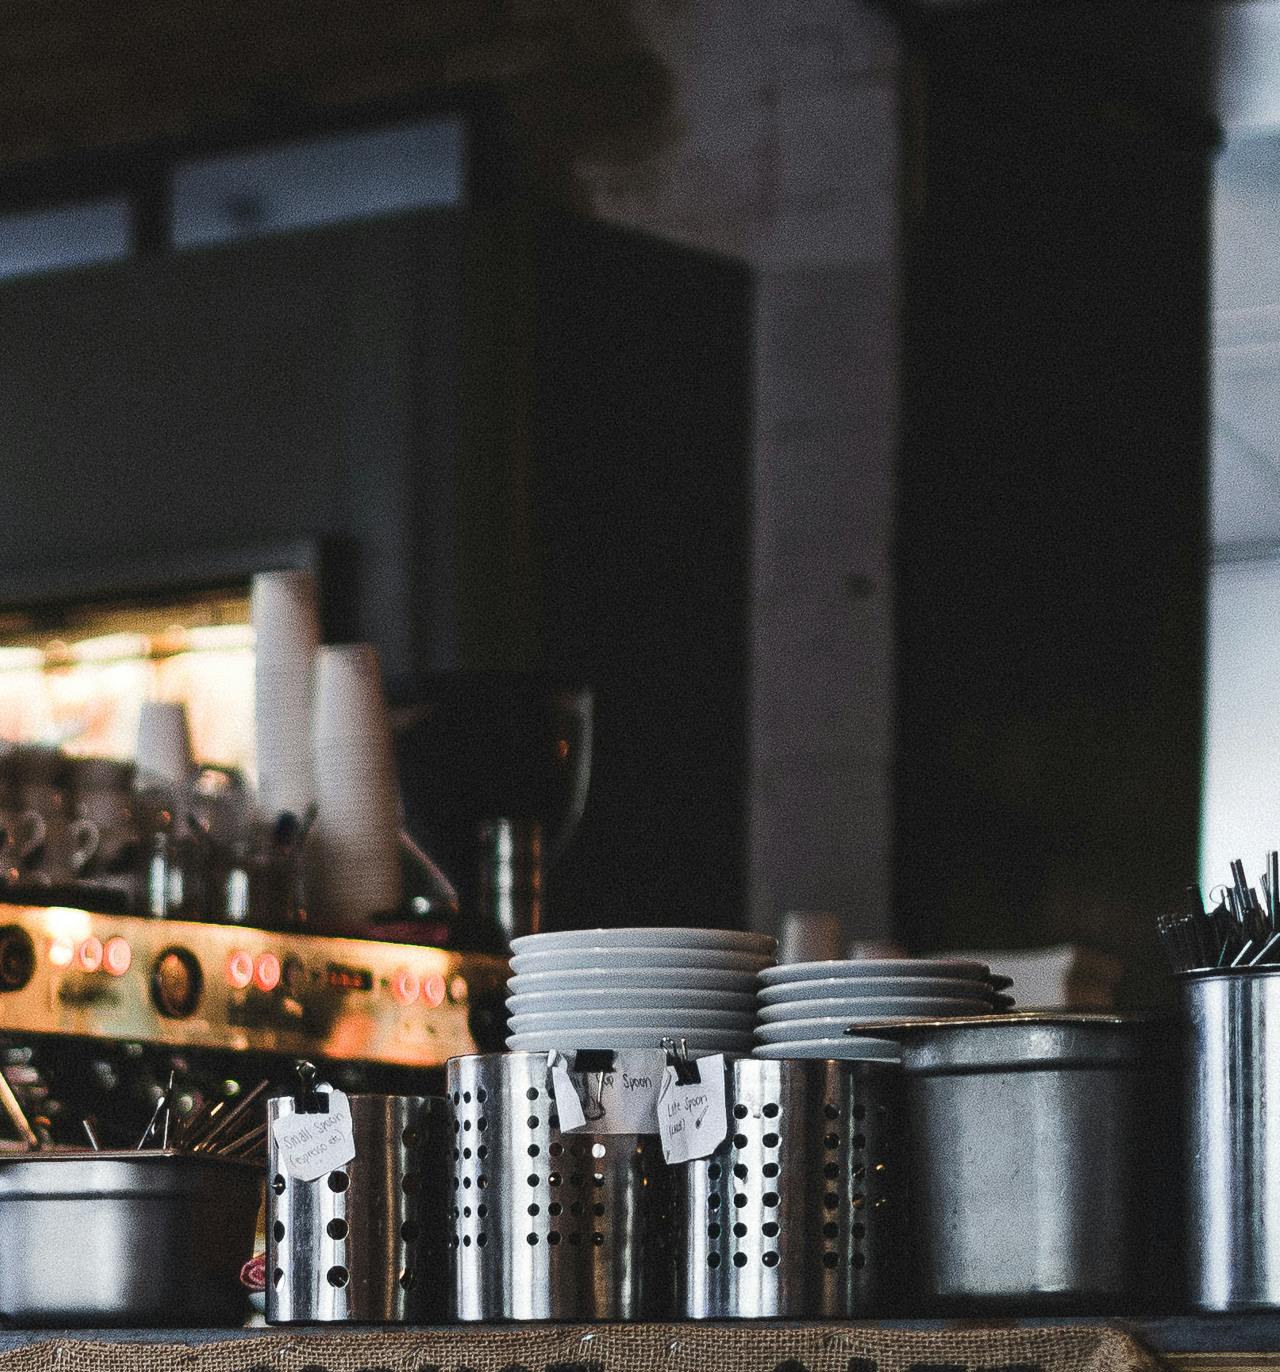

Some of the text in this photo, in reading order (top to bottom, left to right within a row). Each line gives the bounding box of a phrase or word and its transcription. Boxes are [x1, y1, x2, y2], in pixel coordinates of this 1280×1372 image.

[622, 1073, 653, 1092] Spoon
[283, 1112, 345, 1149] Small Spoon
